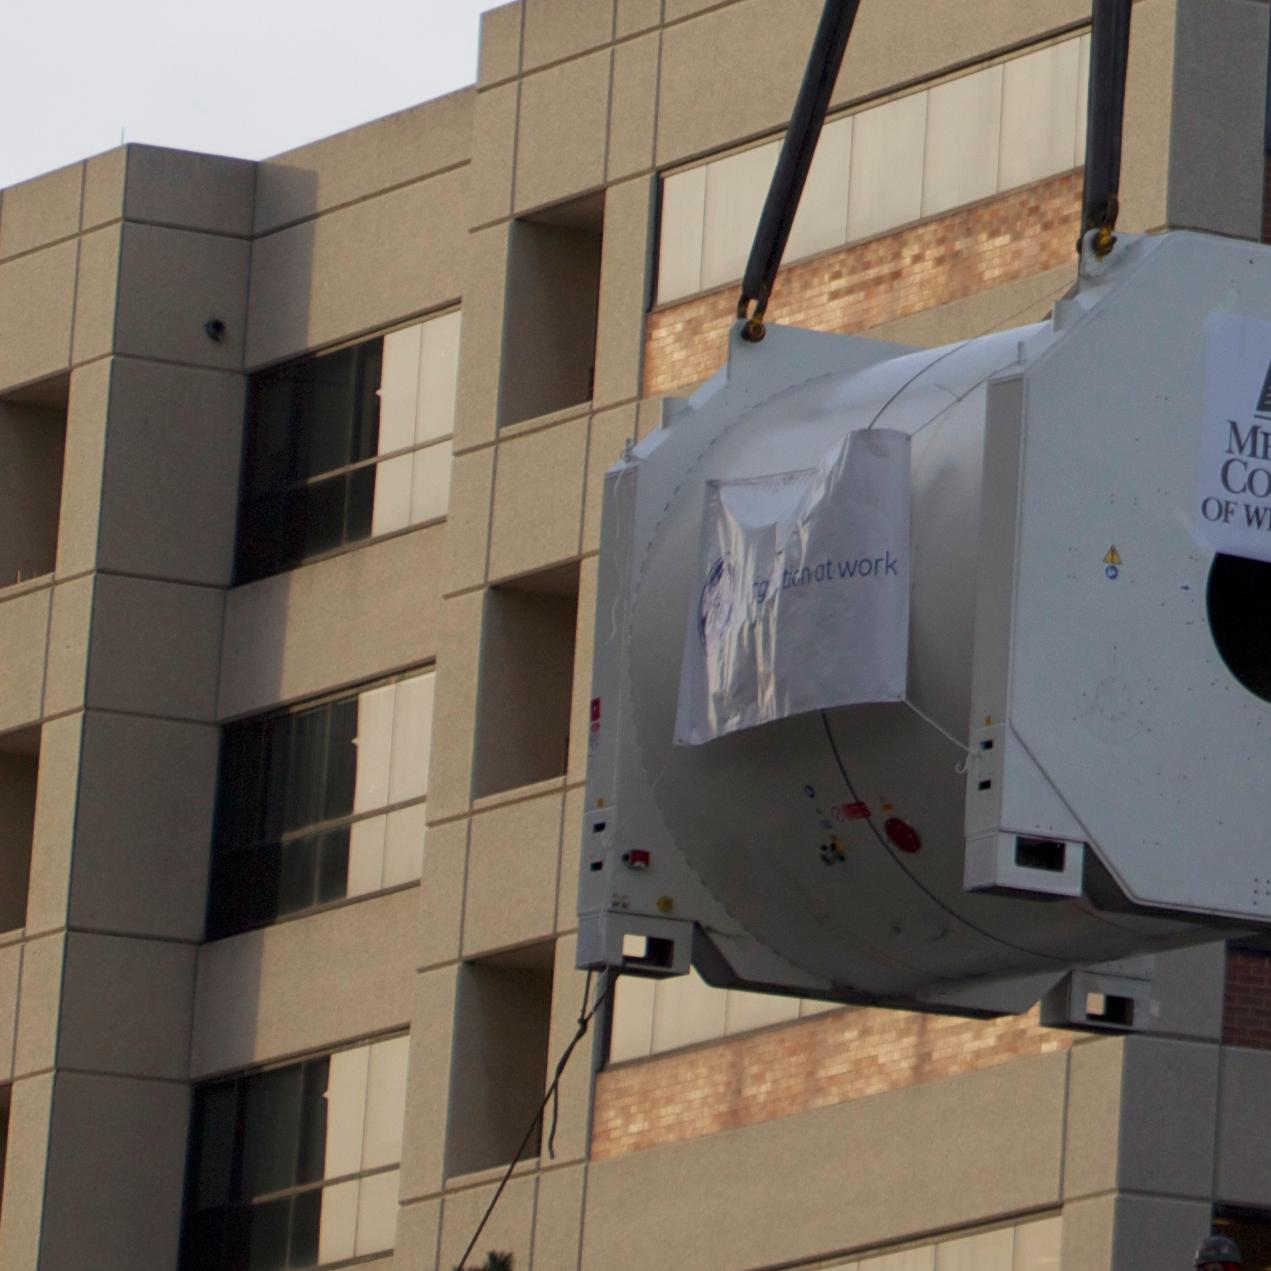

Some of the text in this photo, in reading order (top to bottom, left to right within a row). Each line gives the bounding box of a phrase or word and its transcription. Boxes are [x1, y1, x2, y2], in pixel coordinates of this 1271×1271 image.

[1201, 496, 1237, 524] OF
[815, 561, 833, 583] at
[838, 551, 898, 577] work
